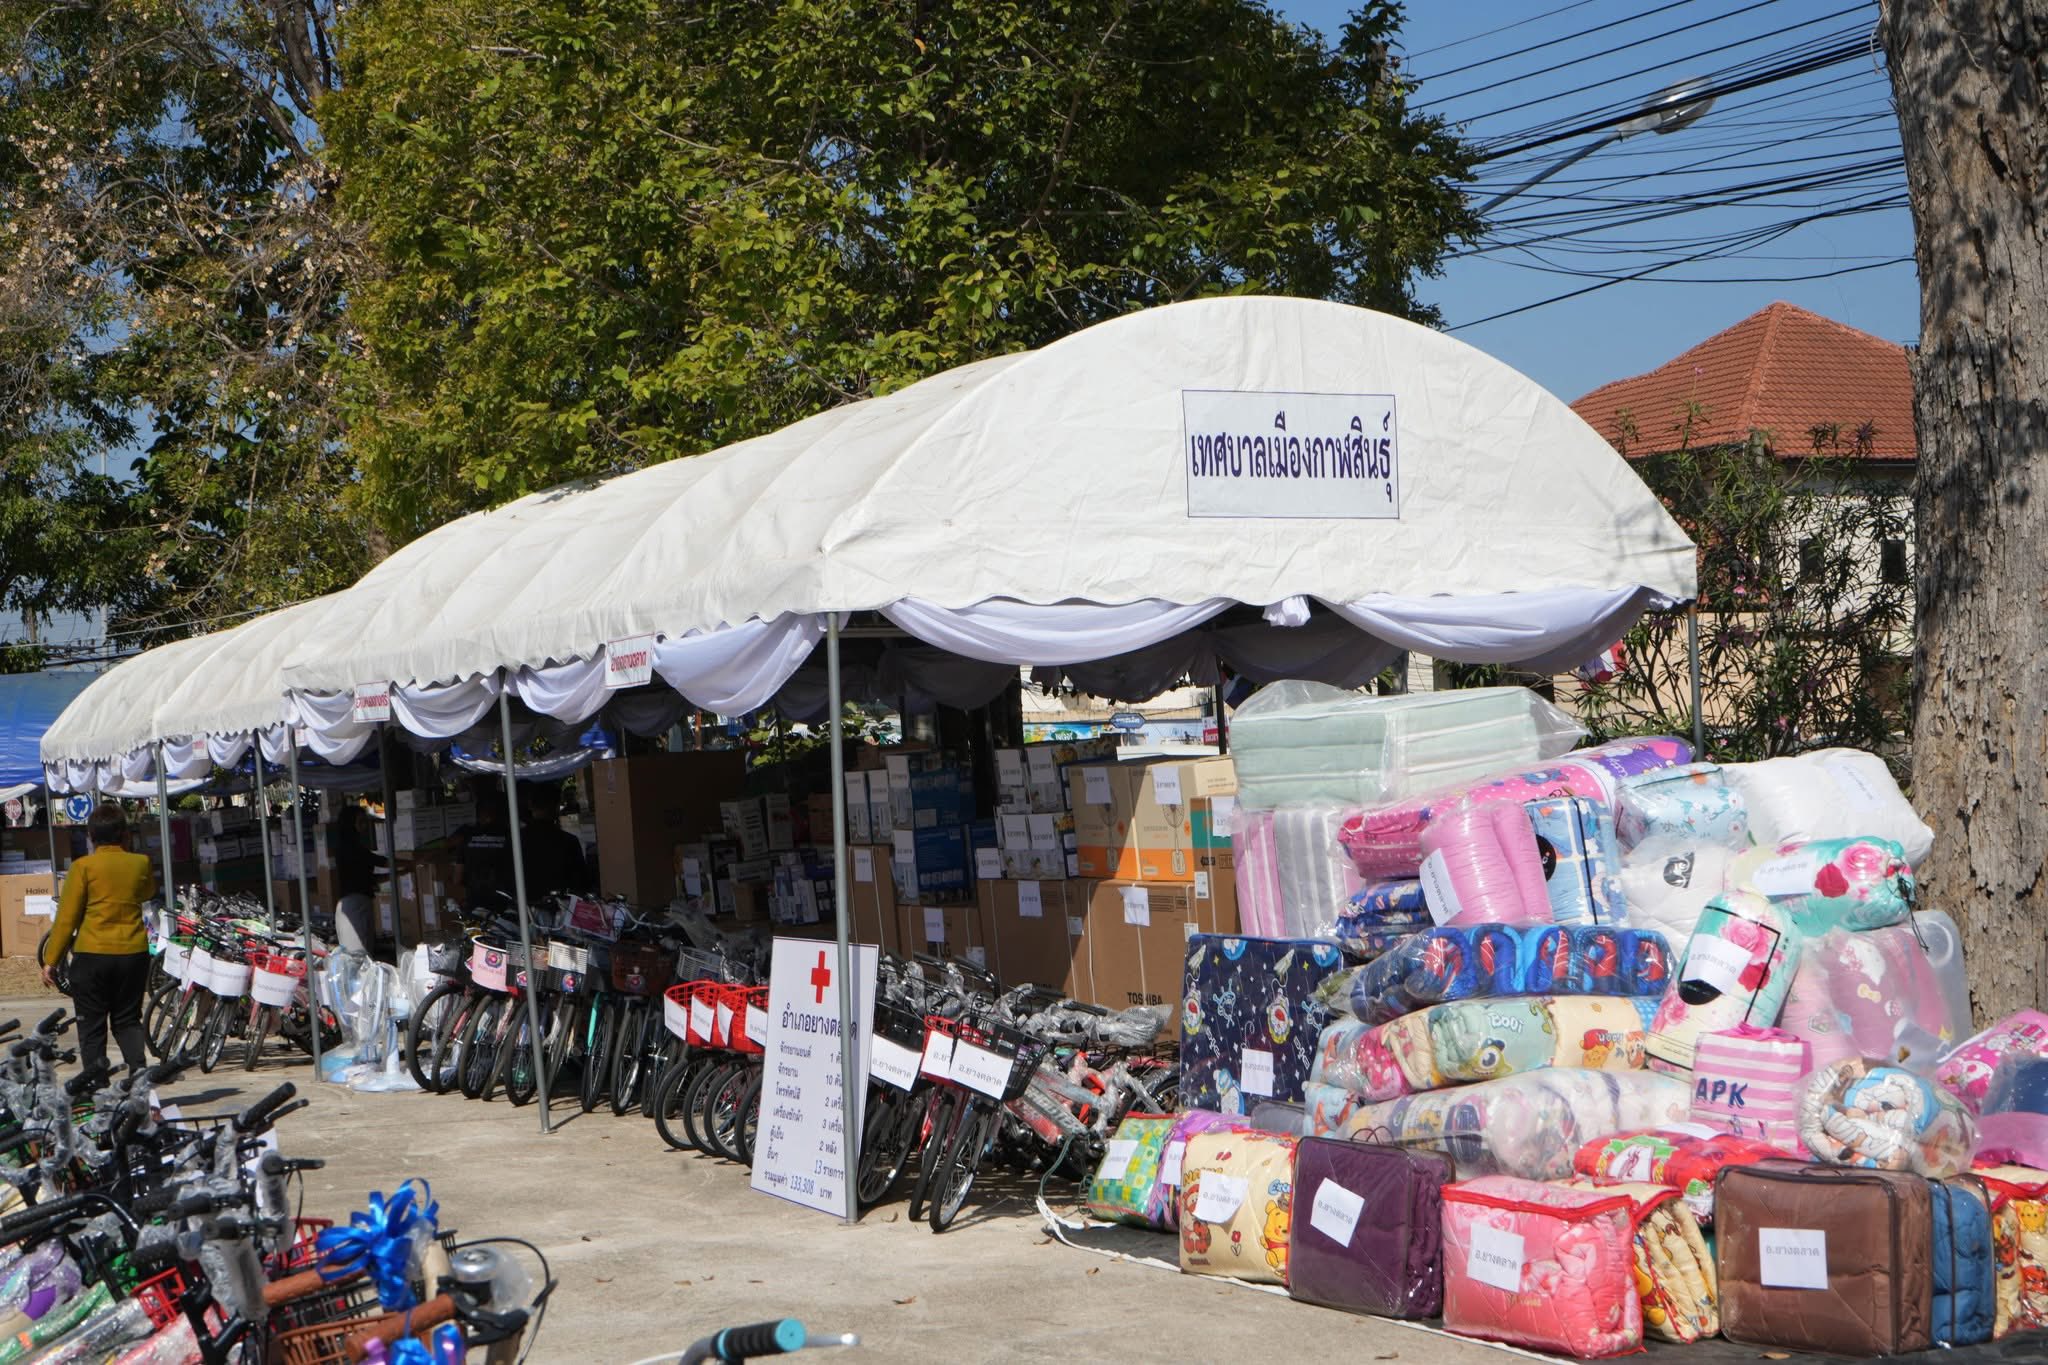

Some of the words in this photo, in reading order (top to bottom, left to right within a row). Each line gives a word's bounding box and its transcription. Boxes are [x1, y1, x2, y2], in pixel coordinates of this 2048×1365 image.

[1190, 410, 1393, 503] เทศบาลเมืองกาฬสินธุ์
[1127, 992, 1163, 1006] TOSHIBA
[825, 1074, 833, 1085] 10
[1696, 1077, 1748, 1109] APK
